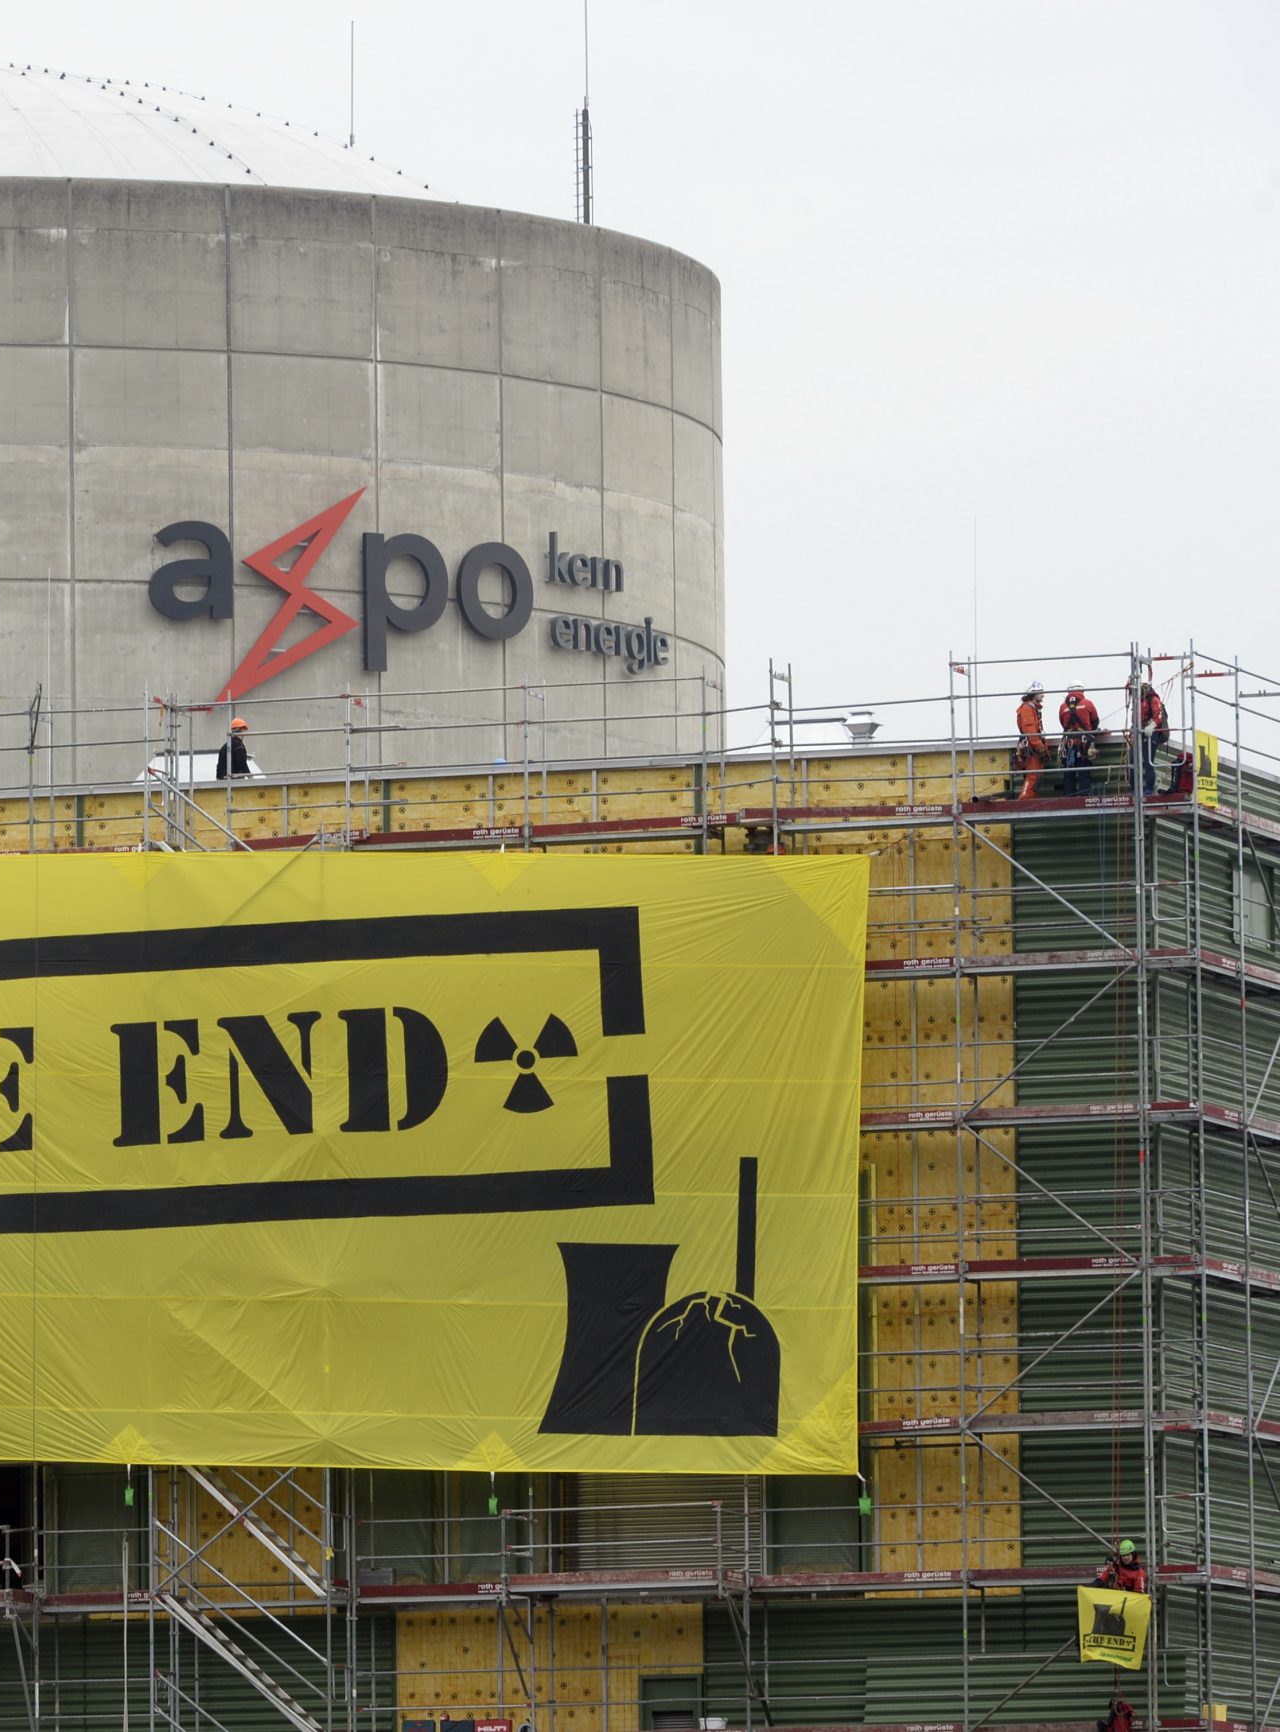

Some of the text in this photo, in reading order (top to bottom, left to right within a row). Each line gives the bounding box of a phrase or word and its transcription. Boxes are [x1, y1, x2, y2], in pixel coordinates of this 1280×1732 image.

[549, 531, 624, 592] kern
[550, 614, 669, 675] energie
[698, 815, 728, 823] grüste
[109, 1006, 449, 1148] END
[1107, 1637, 1125, 1647] END
